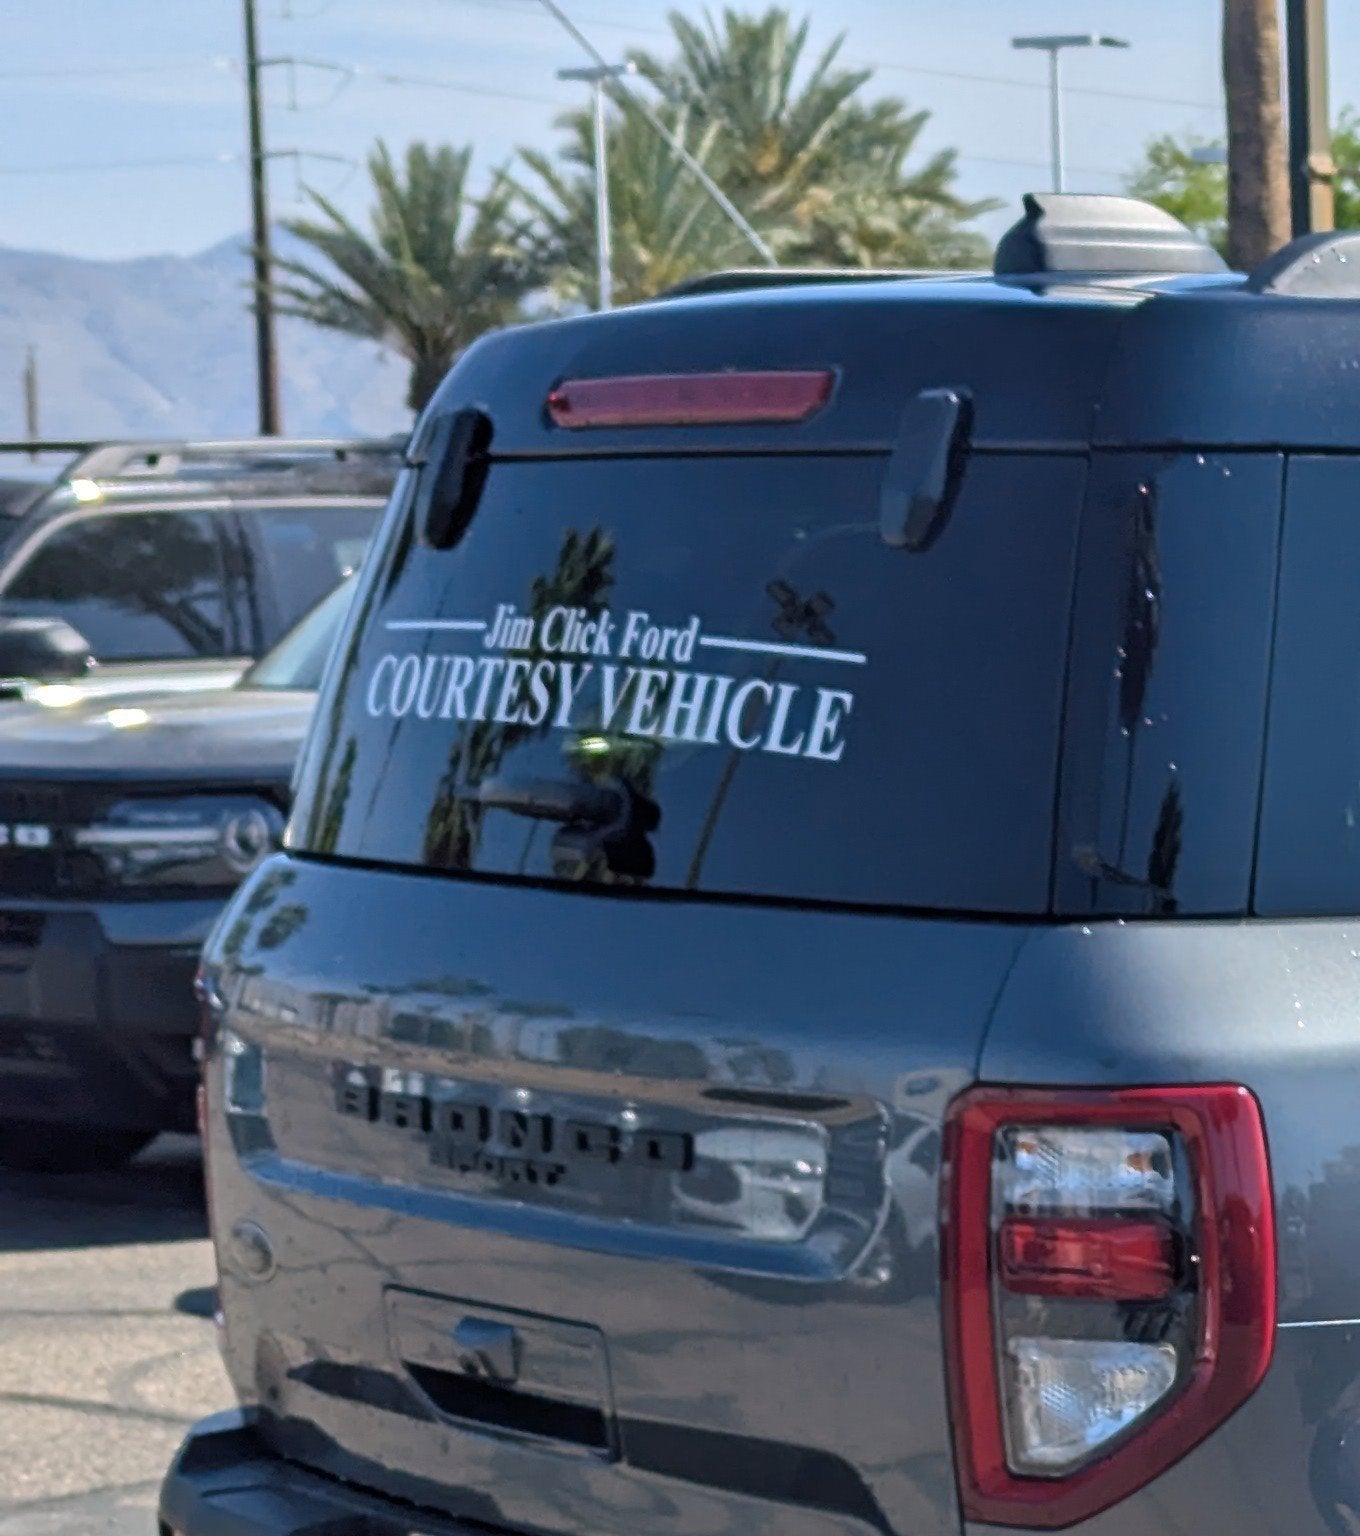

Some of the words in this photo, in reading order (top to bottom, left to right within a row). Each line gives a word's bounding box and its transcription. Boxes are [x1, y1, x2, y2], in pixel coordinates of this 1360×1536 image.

[484, 604, 535, 649] Jim
[540, 605, 616, 656] Click
[619, 610, 700, 663] Ford
[367, 655, 594, 726] COURTESY
[602, 665, 854, 761] VEHICLE
